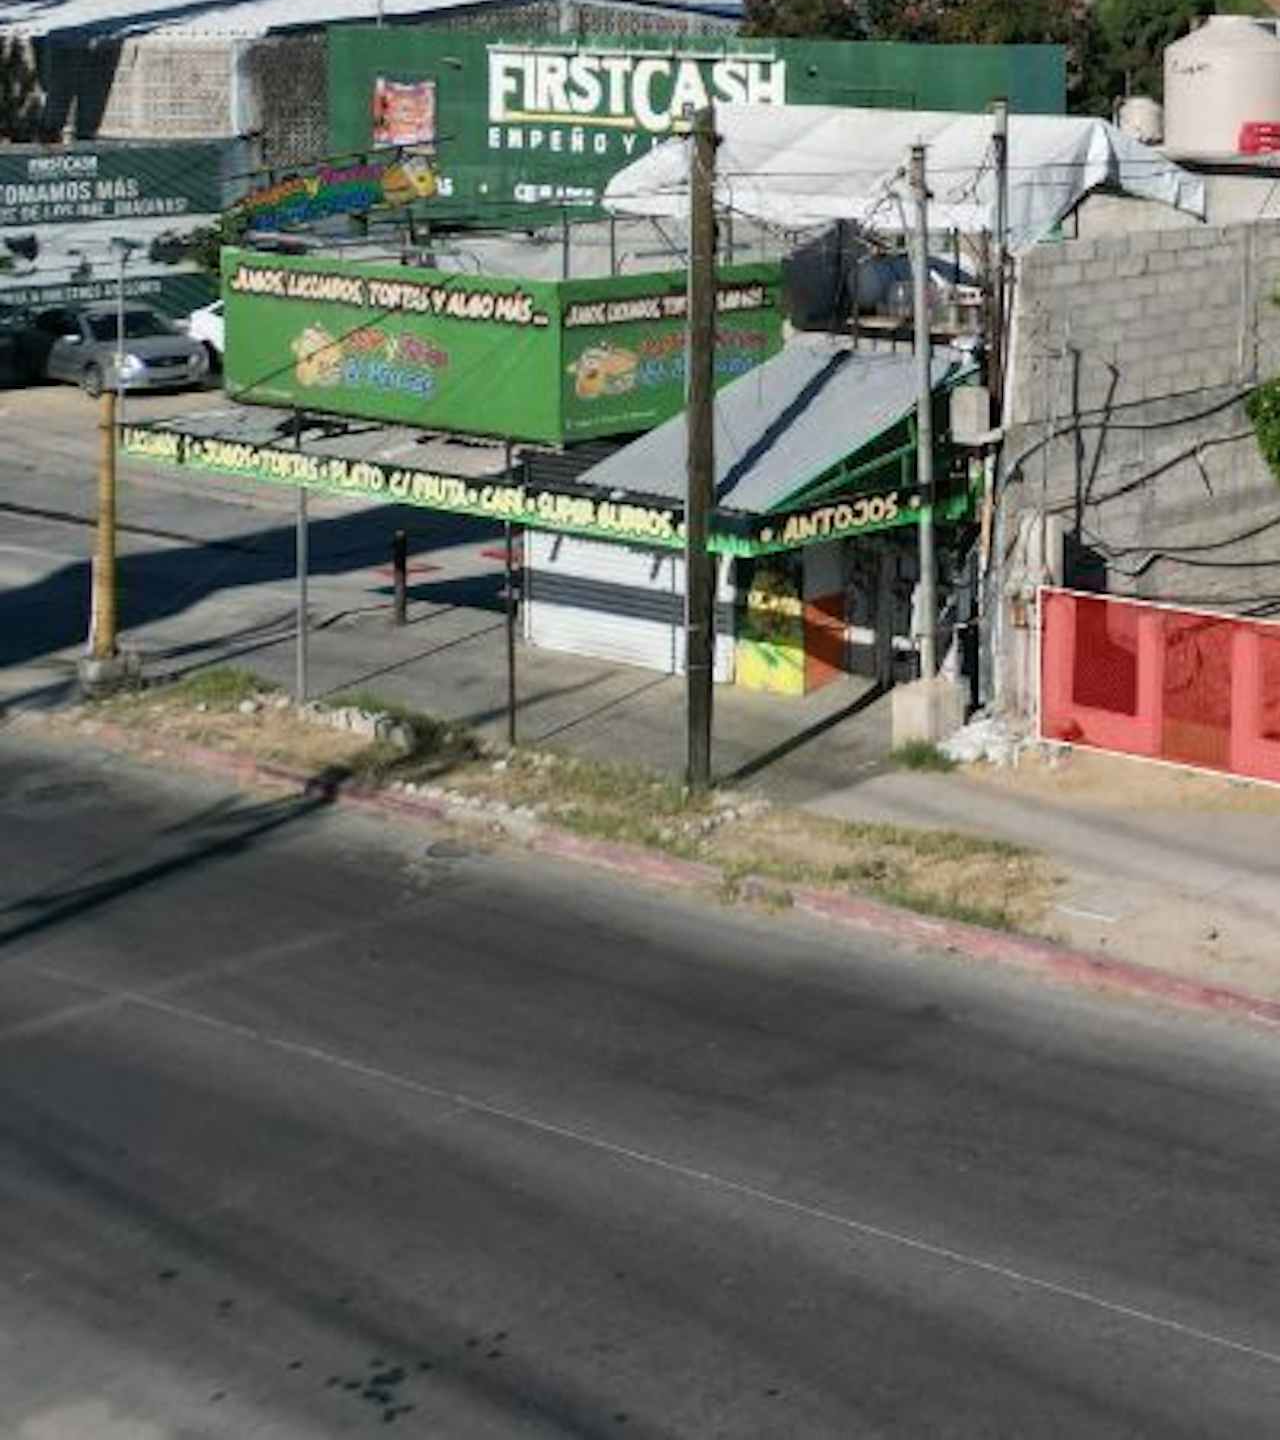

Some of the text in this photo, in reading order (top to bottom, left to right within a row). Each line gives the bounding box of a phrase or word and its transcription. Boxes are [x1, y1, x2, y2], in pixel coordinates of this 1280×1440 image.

[488, 54, 786, 132] FIRSTCASH
[488, 127, 607, 153] EMPEÑO
[783, 491, 898, 543] ANTOJOS
